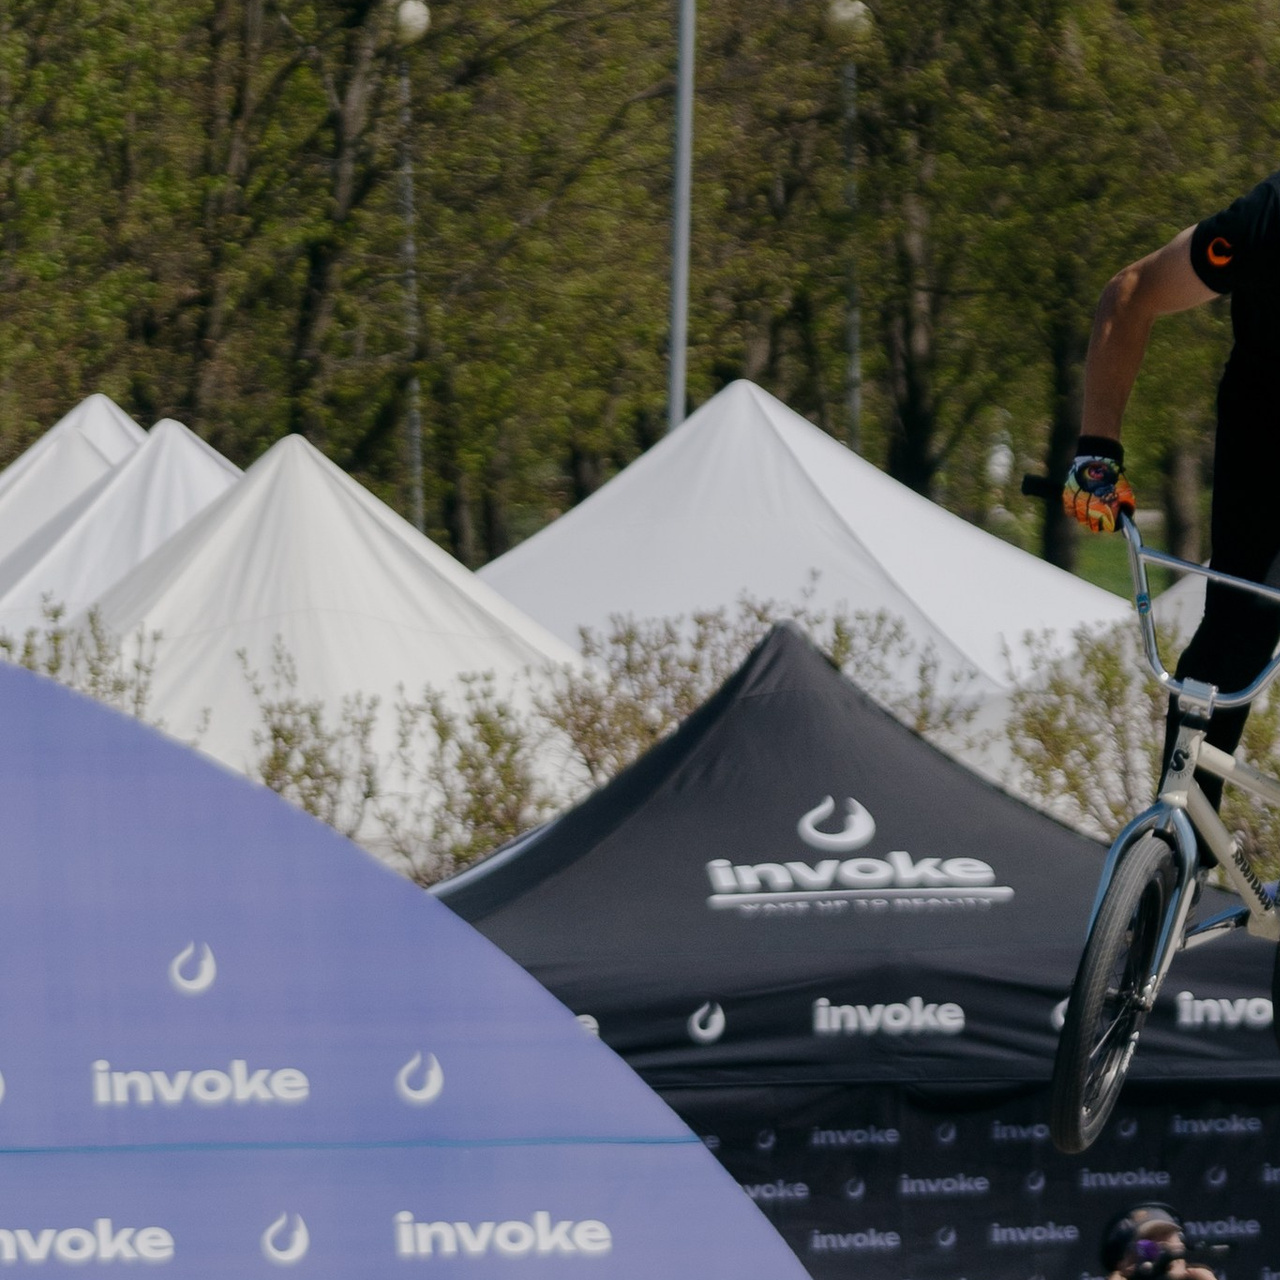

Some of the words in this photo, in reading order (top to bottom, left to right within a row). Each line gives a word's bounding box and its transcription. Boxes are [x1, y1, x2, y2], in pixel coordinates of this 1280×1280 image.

[707, 851, 995, 893] invoke
[740, 901, 810, 914] WAKE
[816, 899, 849, 911] UP
[854, 898, 889, 910] TO
[893, 897, 994, 909] REALITY
[814, 997, 965, 1034] invoke
[93, 1060, 309, 1104] invoke
[811, 1126, 900, 1146] invoke
[992, 1121, 1049, 1141] invo
[1173, 1115, 1261, 1135] invoke
[743, 1179, 808, 1198] voke
[900, 1174, 989, 1195] invoke
[1081, 1168, 1170, 1189] invoke
[0, 1218, 174, 1262] voke
[396, 1211, 612, 1256] invoke
[811, 1228, 900, 1251] invoke
[991, 1222, 1078, 1243] invoke
[1183, 1216, 1260, 1236] nvoke
